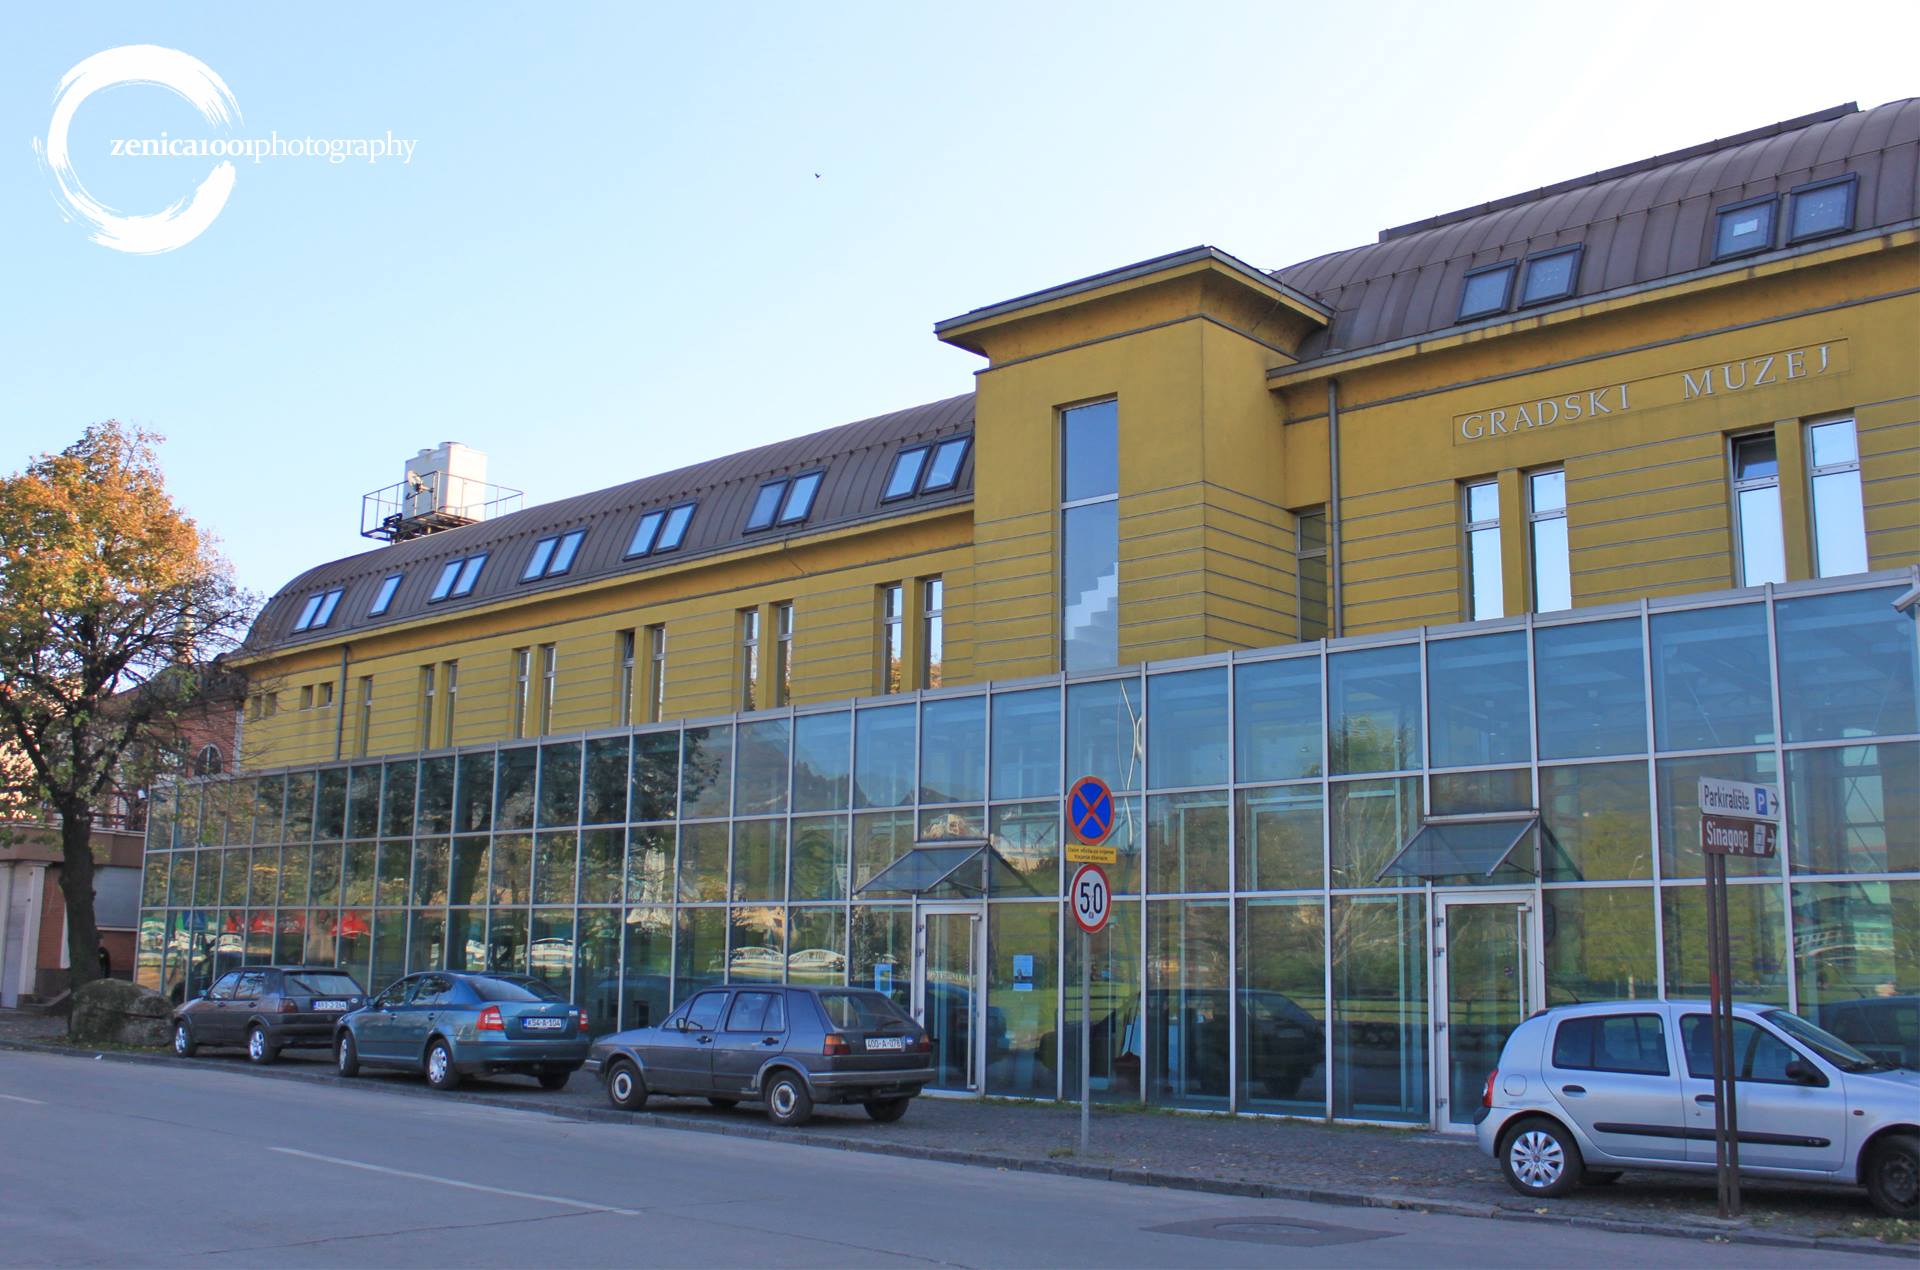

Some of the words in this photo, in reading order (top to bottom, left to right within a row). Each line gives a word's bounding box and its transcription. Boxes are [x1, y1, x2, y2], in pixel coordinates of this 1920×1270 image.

[1461, 383, 1630, 440] GRADSKI
[1682, 345, 1831, 399] MUZEJ
[1706, 820, 1749, 854] Sinagoga
[1080, 881, 1103, 914] 50
